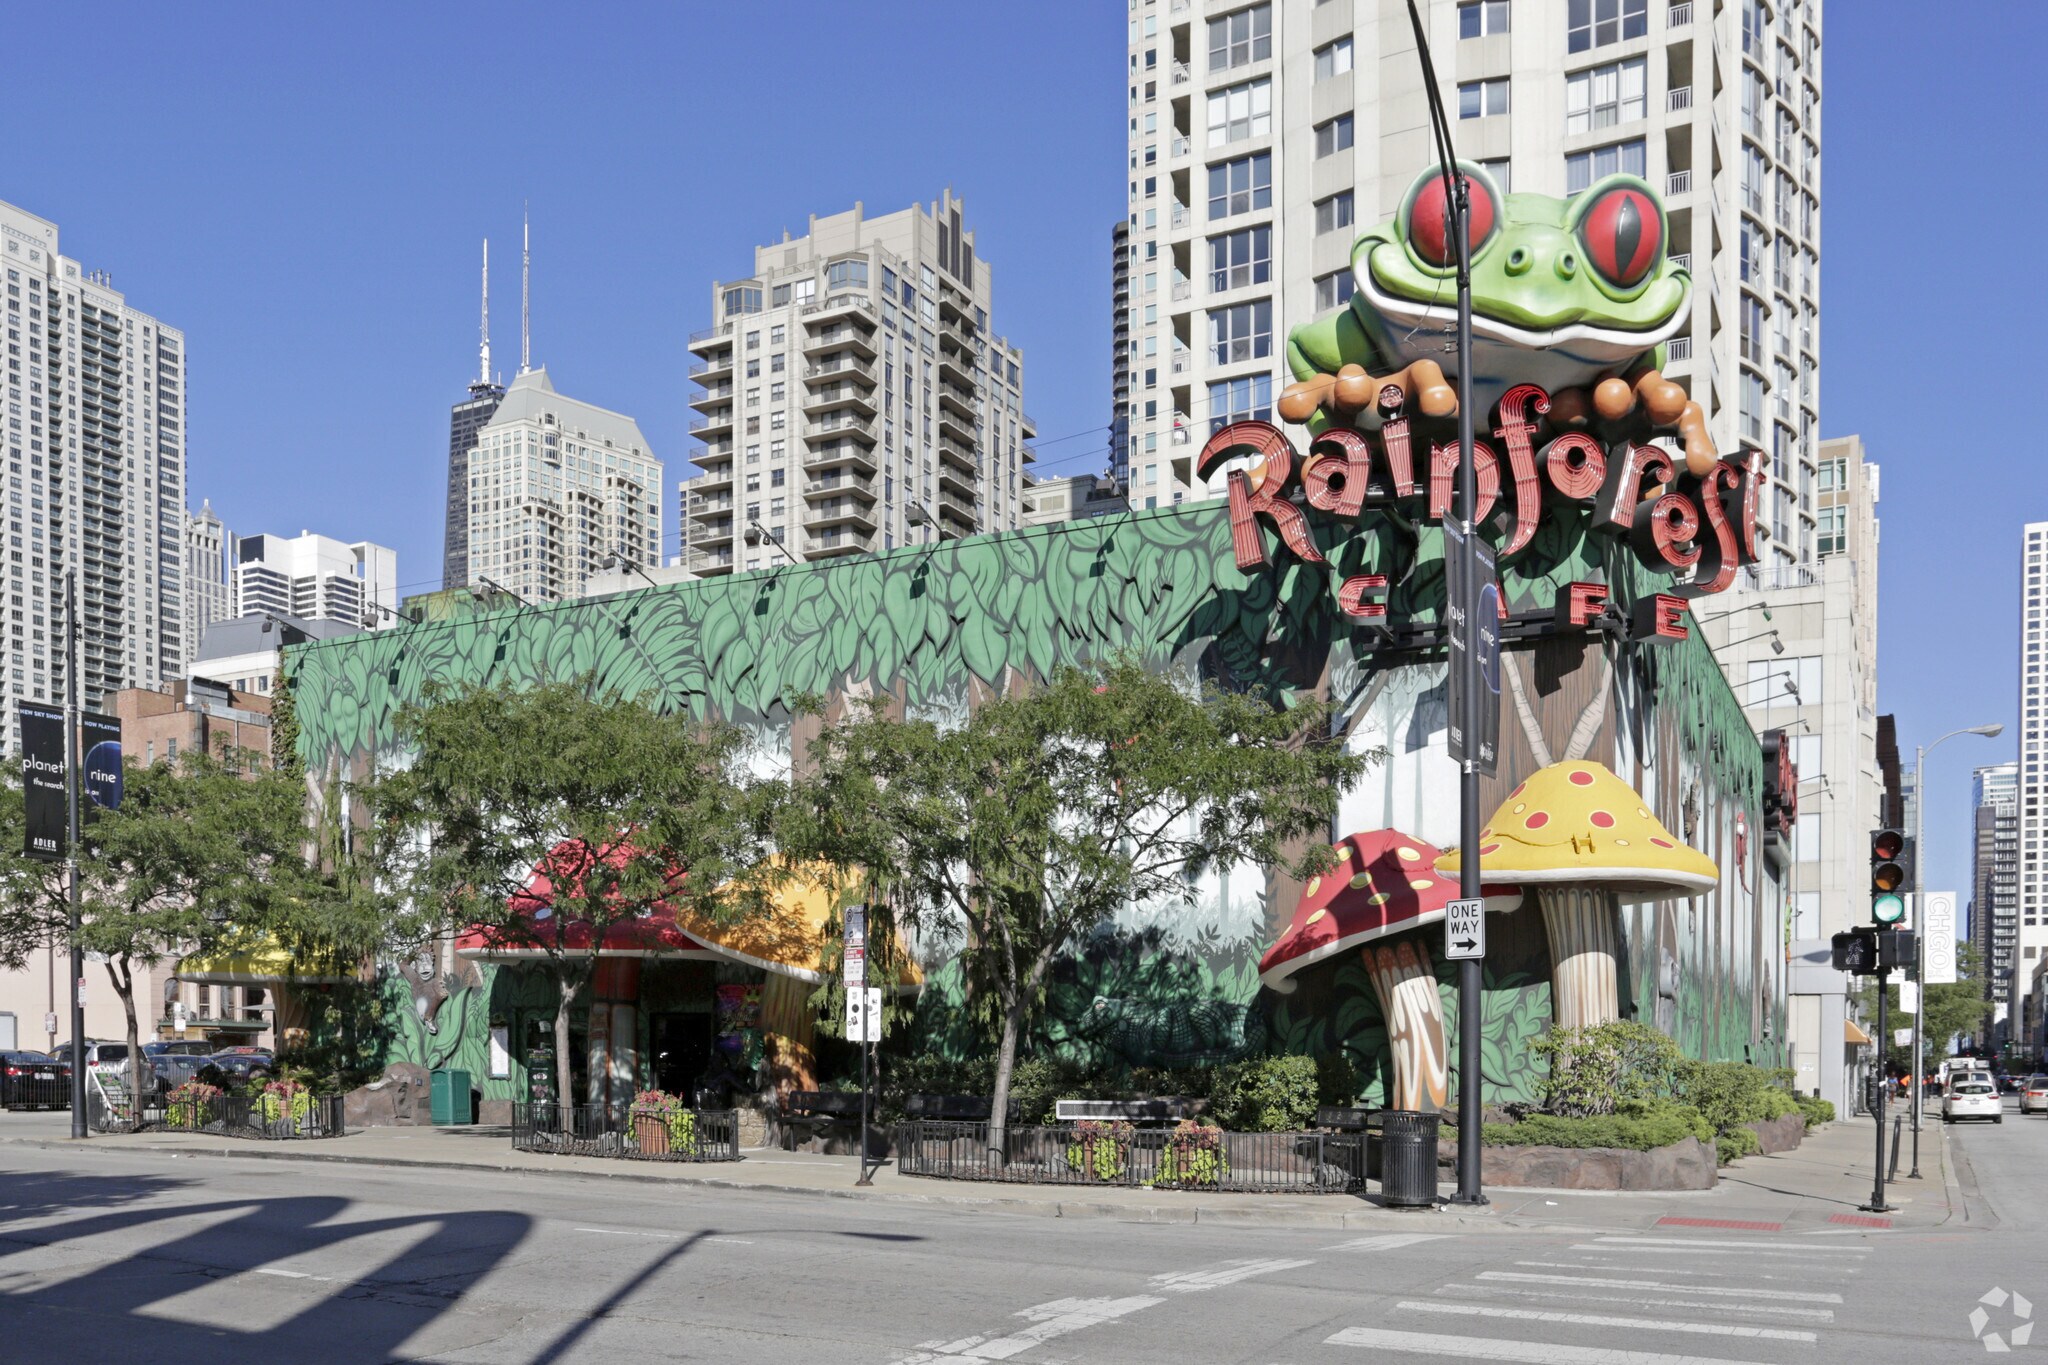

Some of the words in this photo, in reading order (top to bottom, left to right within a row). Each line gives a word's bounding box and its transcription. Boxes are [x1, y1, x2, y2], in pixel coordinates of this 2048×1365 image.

[1197, 384, 1767, 595] Rainforest
[1338, 574, 1690, 641] CFE
[23, 753, 65, 774] planet
[33, 777, 43, 786] the
[91, 769, 117, 783] nine
[33, 837, 57, 848] ADLER
[1451, 904, 1479, 918] ONE
[1450, 920, 1479, 934] WAY
[1929, 896, 1951, 970] CHGO
